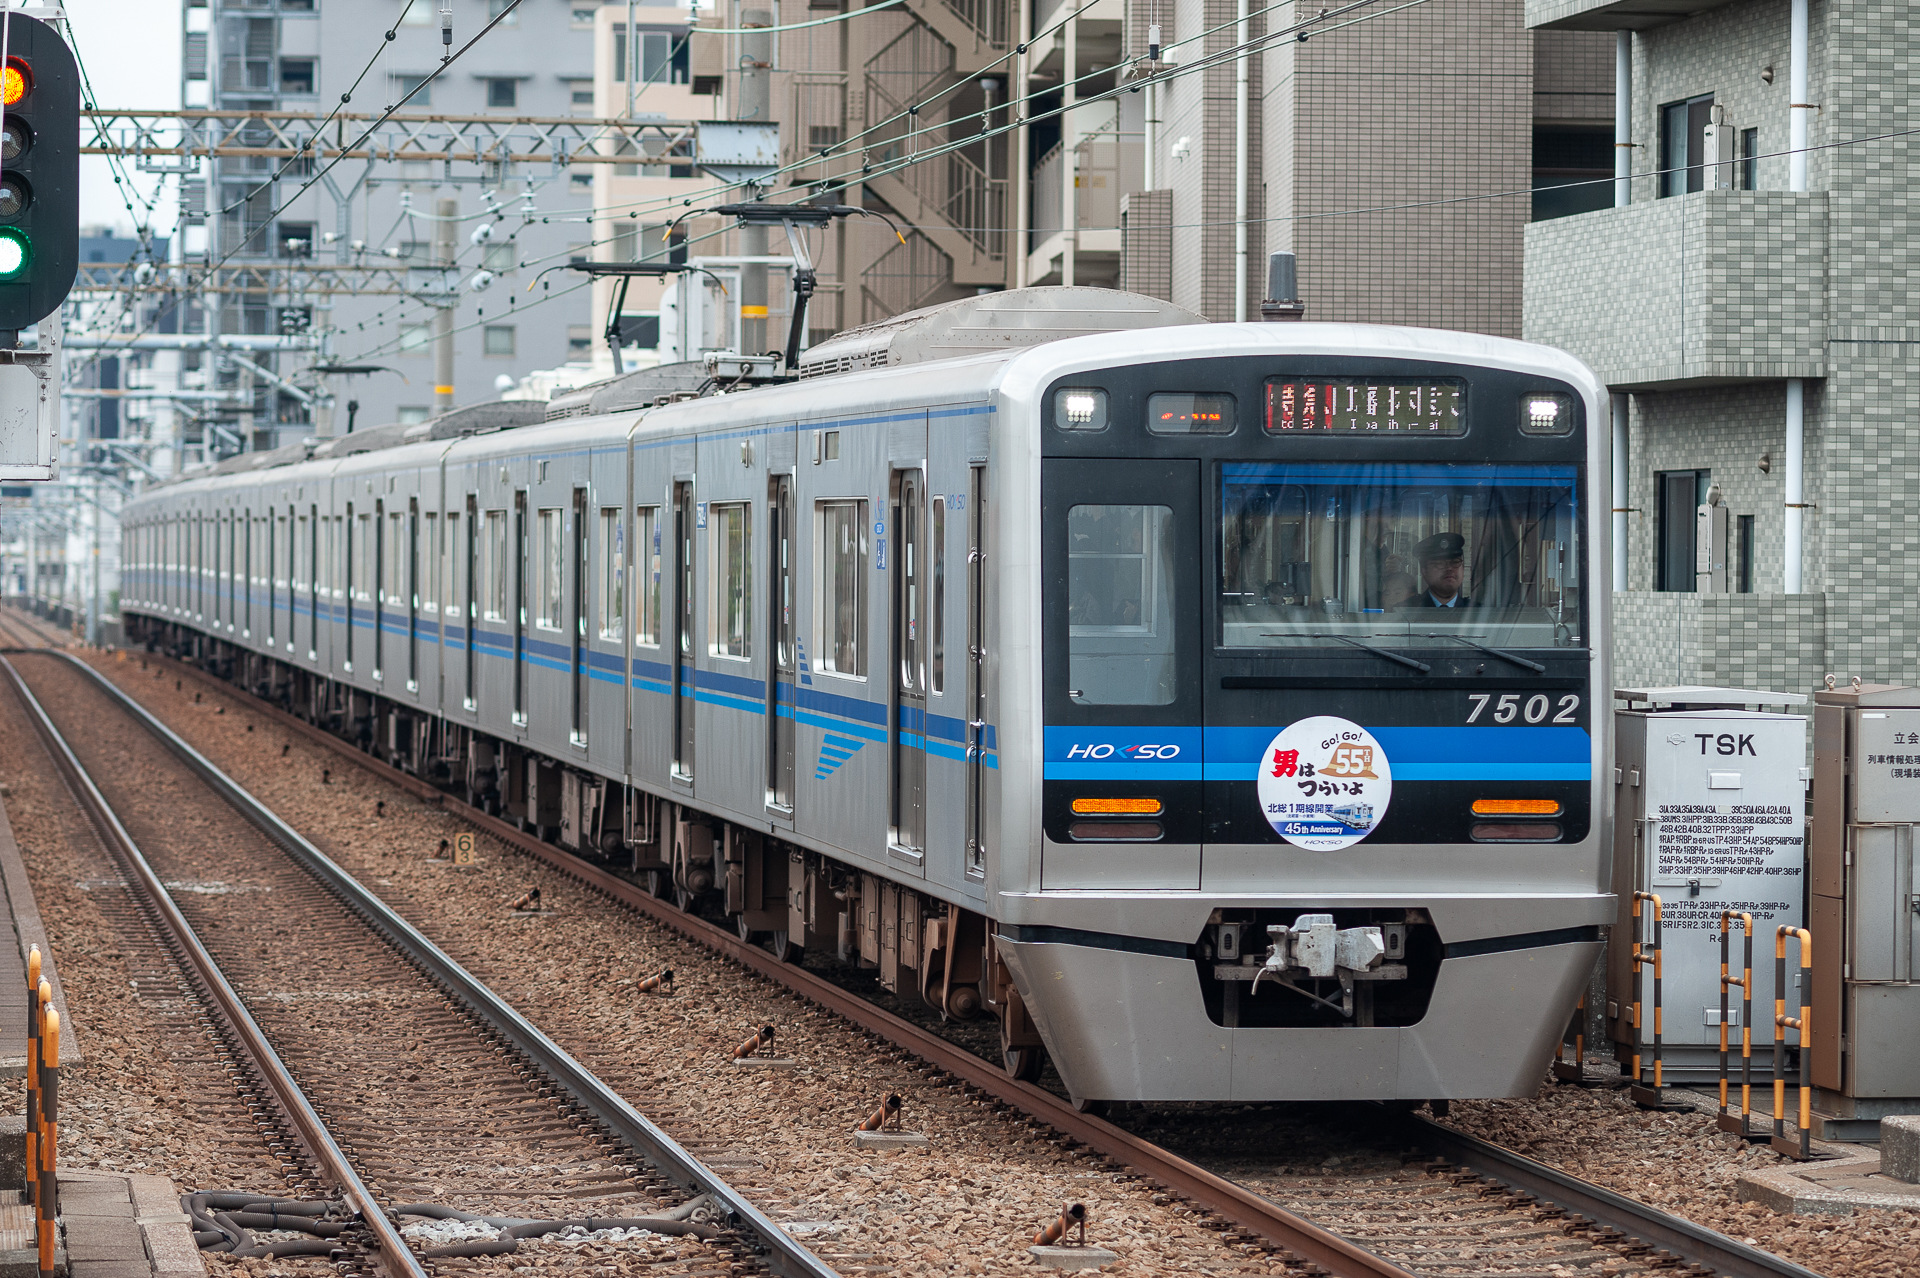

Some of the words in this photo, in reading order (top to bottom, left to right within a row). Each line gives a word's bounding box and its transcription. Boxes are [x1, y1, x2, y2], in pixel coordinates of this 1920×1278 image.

[1466, 694, 1580, 724] 7502
[1321, 733, 1340, 750] Go!
[1341, 731, 1363, 742] Go!
[1694, 733, 1757, 756] TSK
[1893, 731, 1920, 745] 立会
[1270, 748, 1316, 778] 男は
[1297, 780, 1364, 797] つらいよ
[1284, 822, 1309, 834] 45th
[1309, 825, 1344, 835] Anniversary
[458, 834, 471, 852] 6
[460, 852, 470, 863] 3
